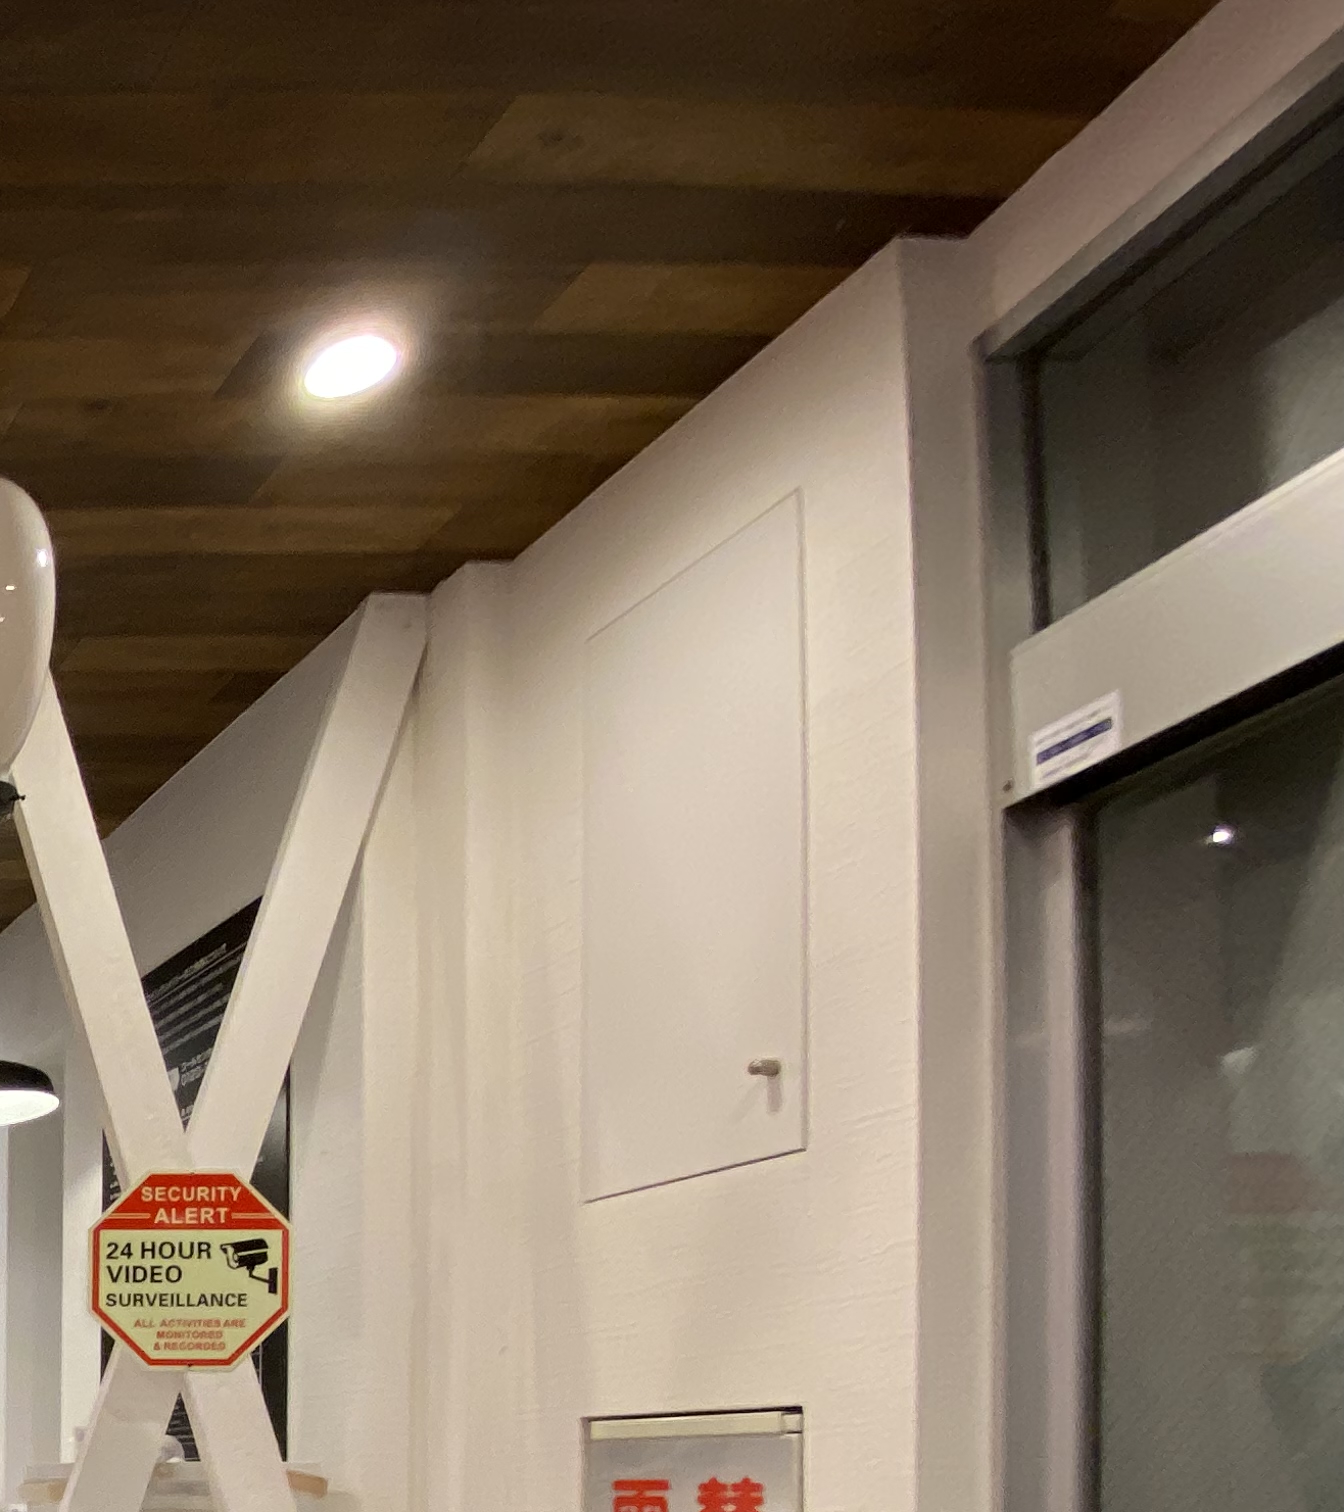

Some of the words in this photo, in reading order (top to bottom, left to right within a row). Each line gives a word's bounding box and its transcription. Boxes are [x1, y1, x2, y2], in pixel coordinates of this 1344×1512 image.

[141, 1186, 242, 1202] SECURITY
[154, 1207, 229, 1225] ALERT
[106, 1242, 134, 1260] 24
[140, 1241, 212, 1260] HOUR
[106, 1265, 183, 1284] VIDEO
[105, 1293, 248, 1308] SURVEILLANCE
[133, 1319, 155, 1328] ALL
[160, 1319, 221, 1328] ACTIVITIES
[222, 1319, 246, 1328] ARE
[156, 1331, 223, 1340] MONITORED
[163, 1342, 226, 1351] RECORDED
